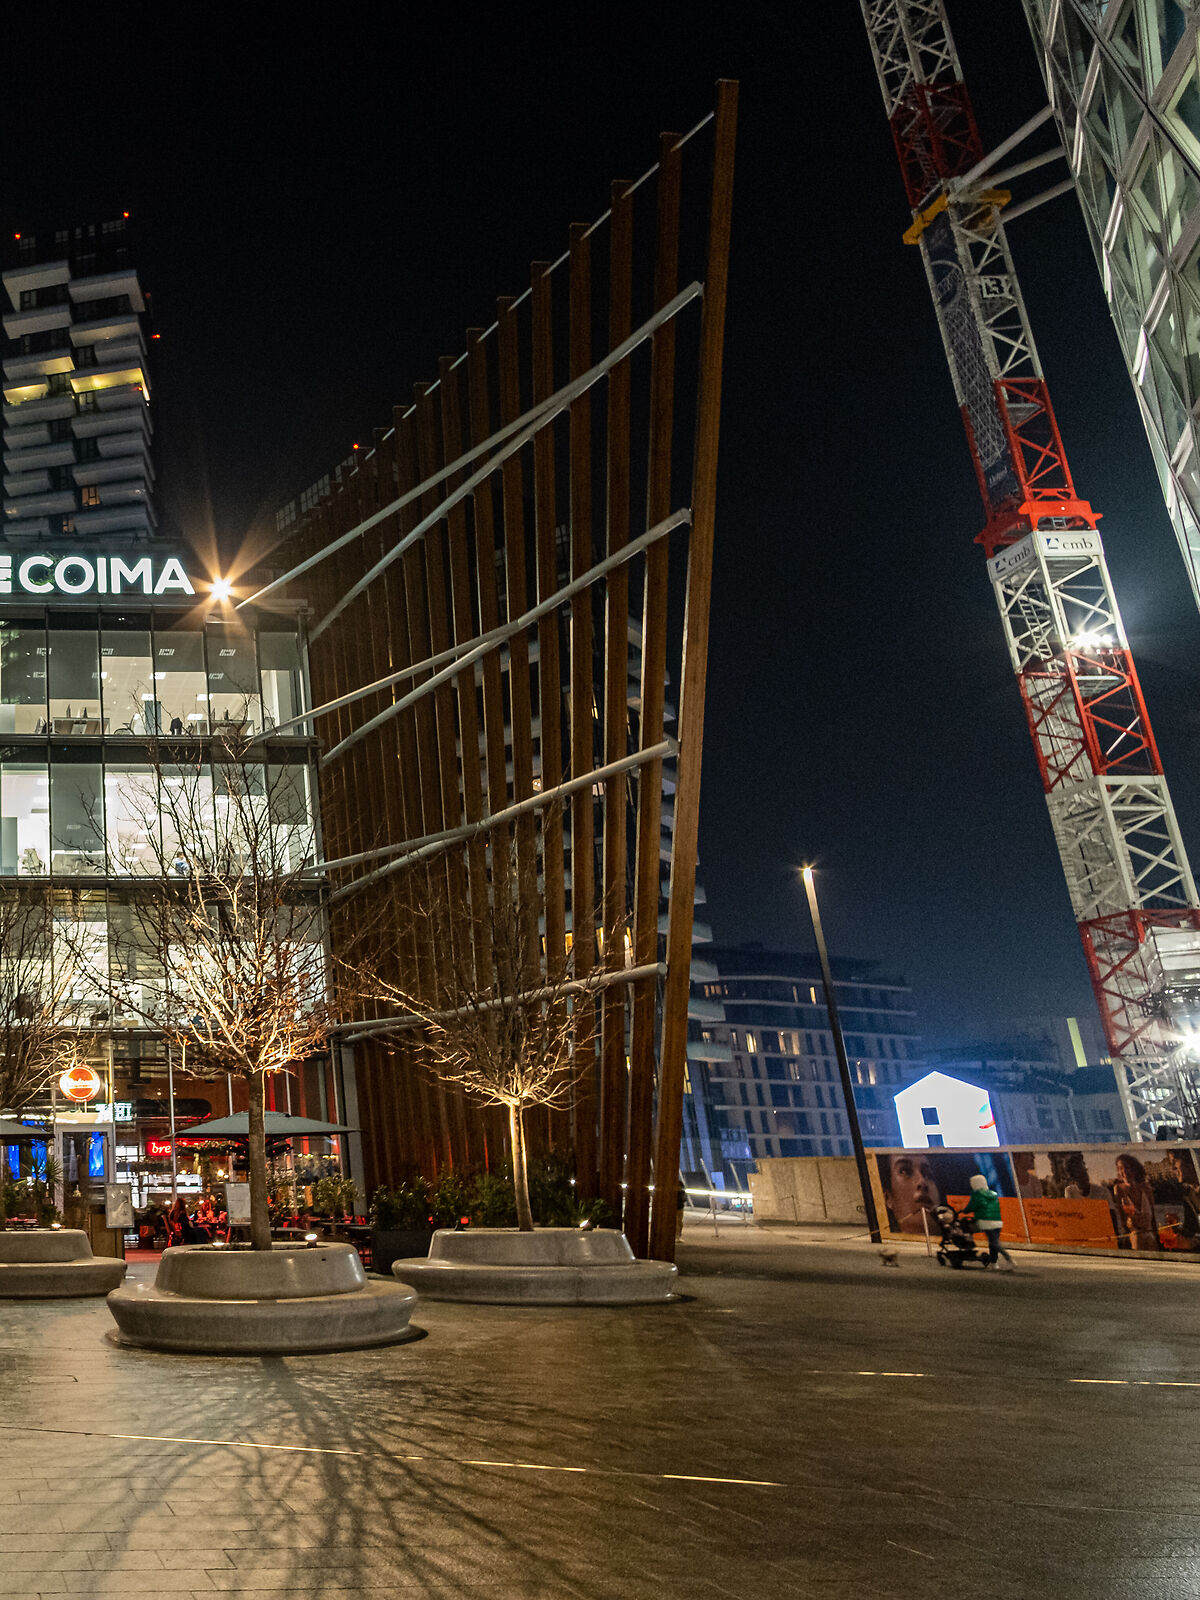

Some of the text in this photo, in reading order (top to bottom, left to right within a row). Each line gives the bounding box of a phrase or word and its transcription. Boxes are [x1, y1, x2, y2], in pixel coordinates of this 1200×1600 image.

[1062, 538, 1093, 550] cmb
[1008, 546, 1031, 567] cmb
[19, 556, 196, 595] COIMA
[152, 1142, 173, 1155] bre
